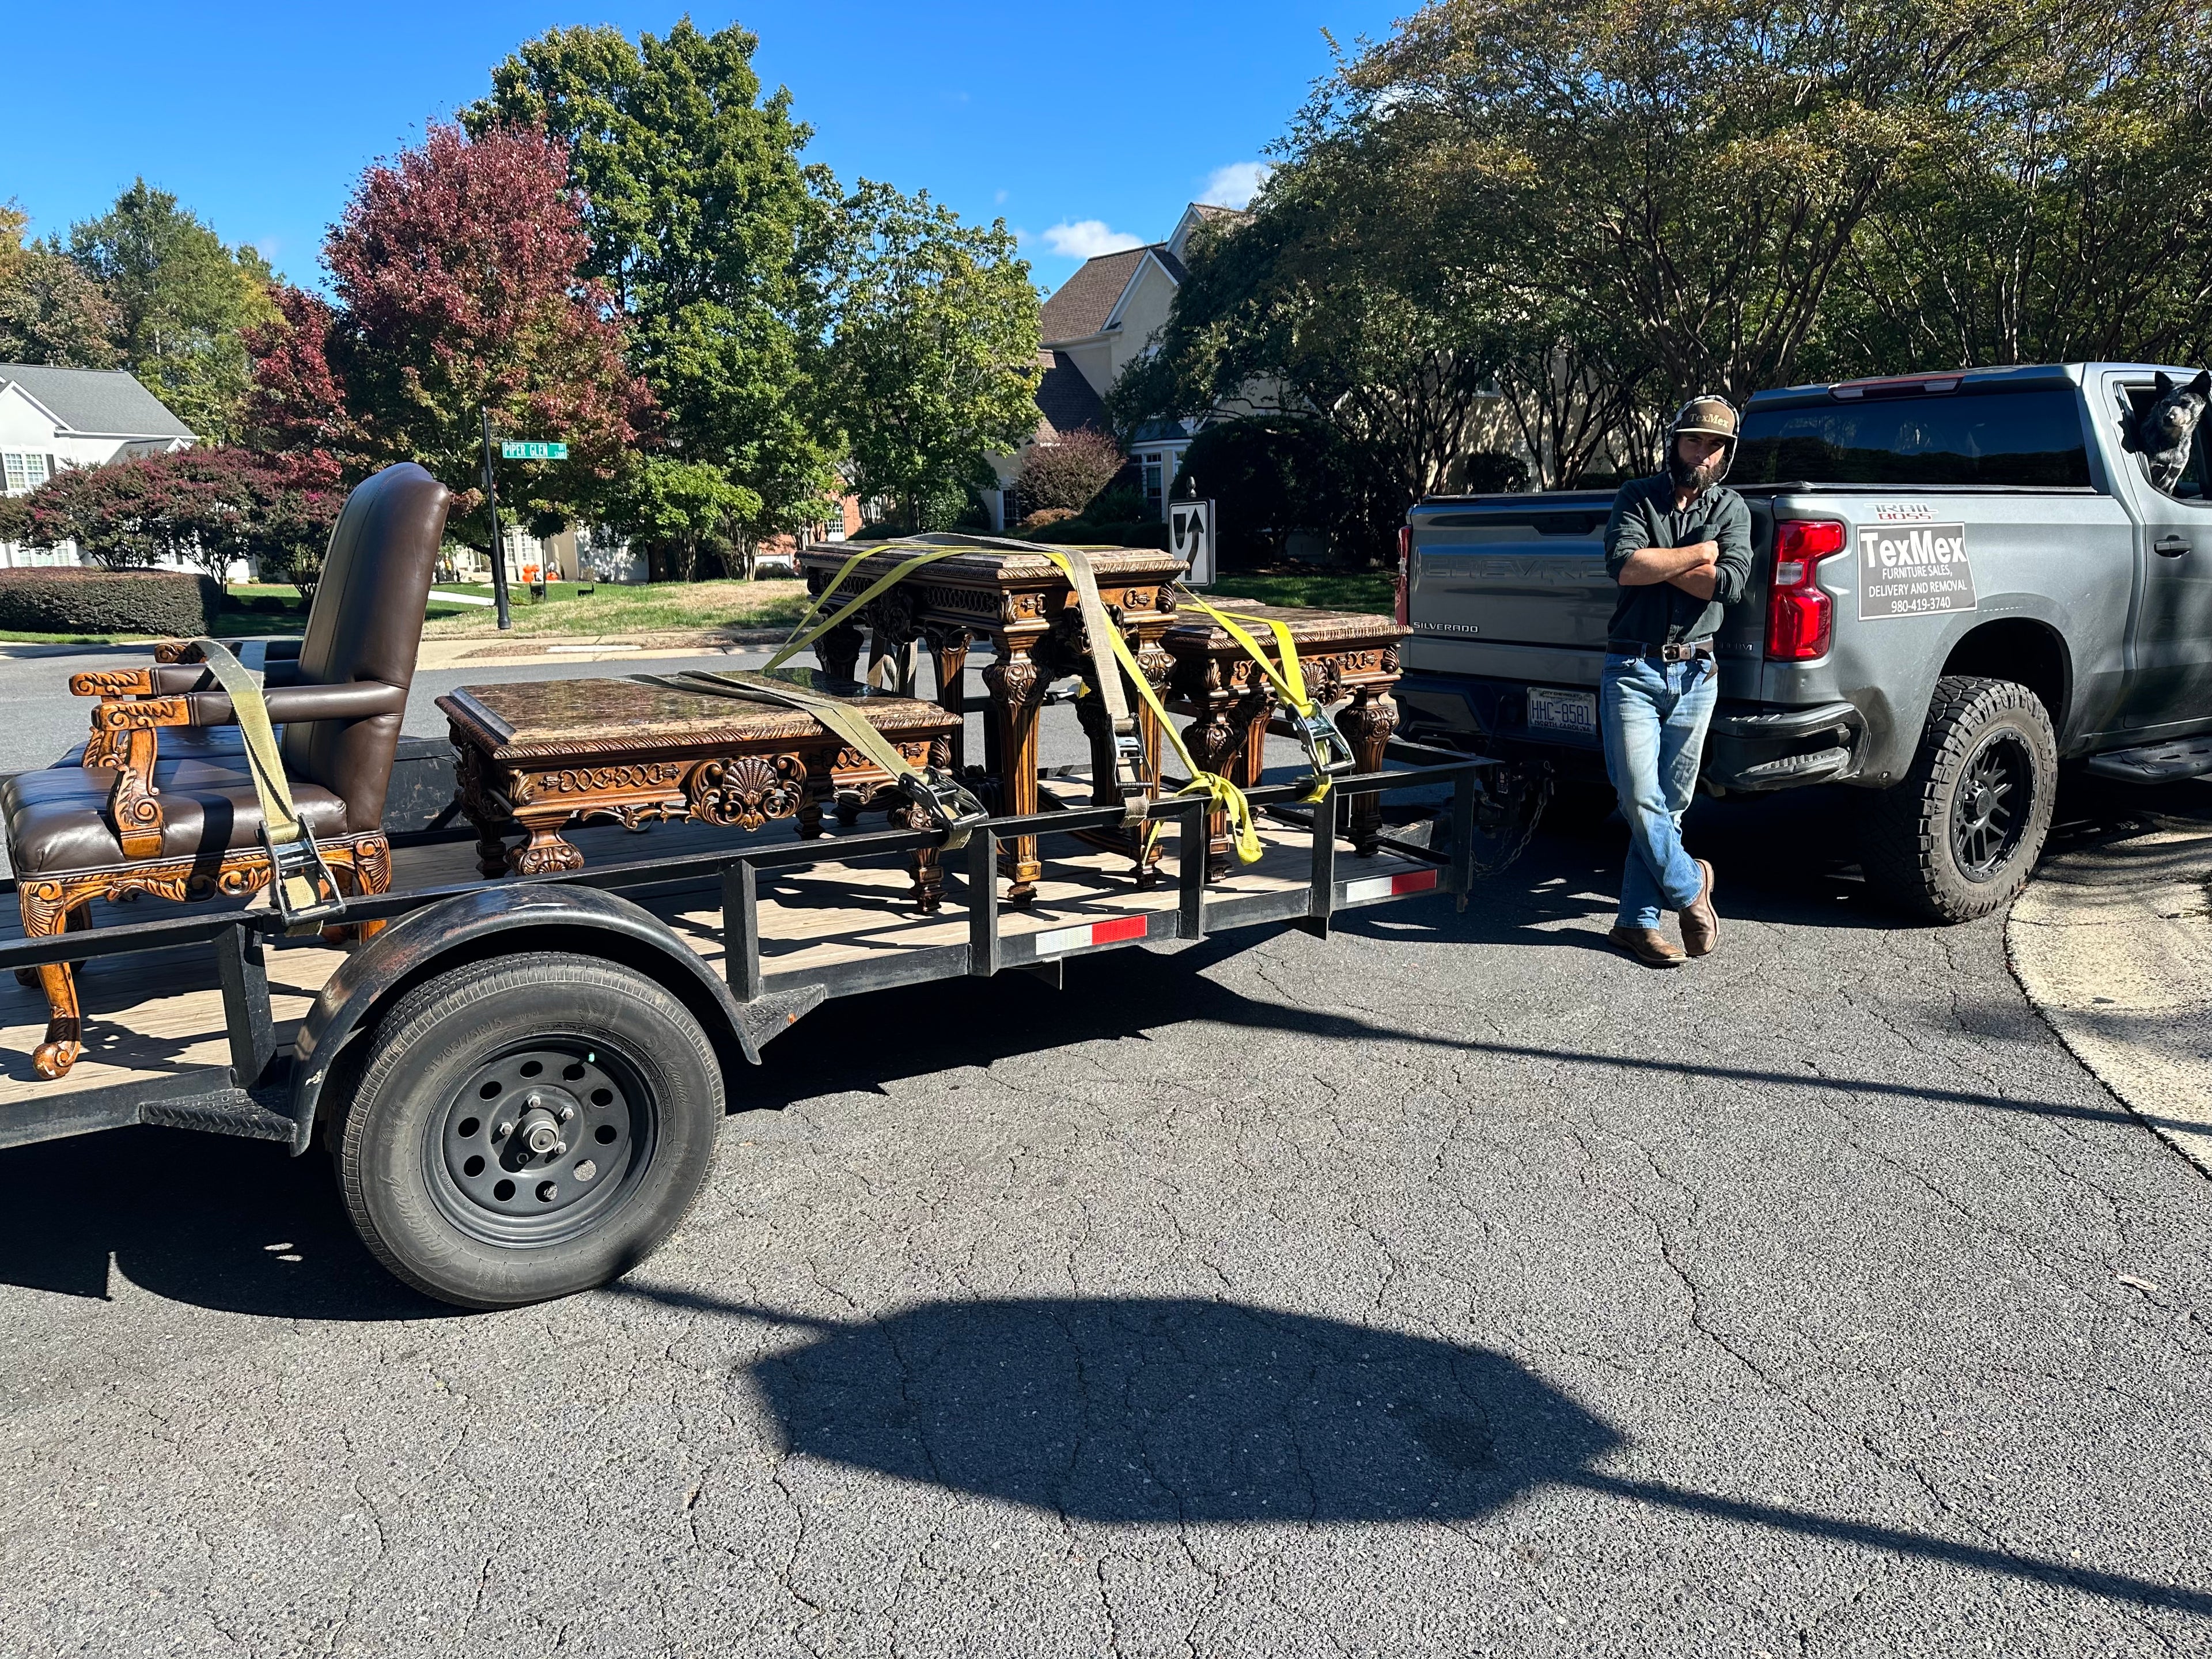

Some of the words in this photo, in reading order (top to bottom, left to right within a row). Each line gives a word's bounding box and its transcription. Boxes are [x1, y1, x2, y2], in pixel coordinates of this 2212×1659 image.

[1690, 413, 1729, 428] TexMex
[504, 444, 525, 456] PIPER
[530, 444, 548, 457] GLEN
[1865, 503, 1937, 513] TRAIL
[1859, 530, 1968, 568] TexMex
[1882, 565, 1927, 580] FURNITURE
[1928, 564, 1953, 577] SALES,
[1868, 583, 1909, 598] DELIVERY
[1910, 582, 1929, 595] AND
[1930, 579, 1968, 594] REMOVAL
[1891, 596, 1951, 613] 980-419-3740
[1414, 622, 1478, 632] SILVERADO
[1532, 699, 1592, 726] HHC-8581
[1534, 720, 1557, 728] NORTH
[1559, 722, 1590, 732] CAROLINA
